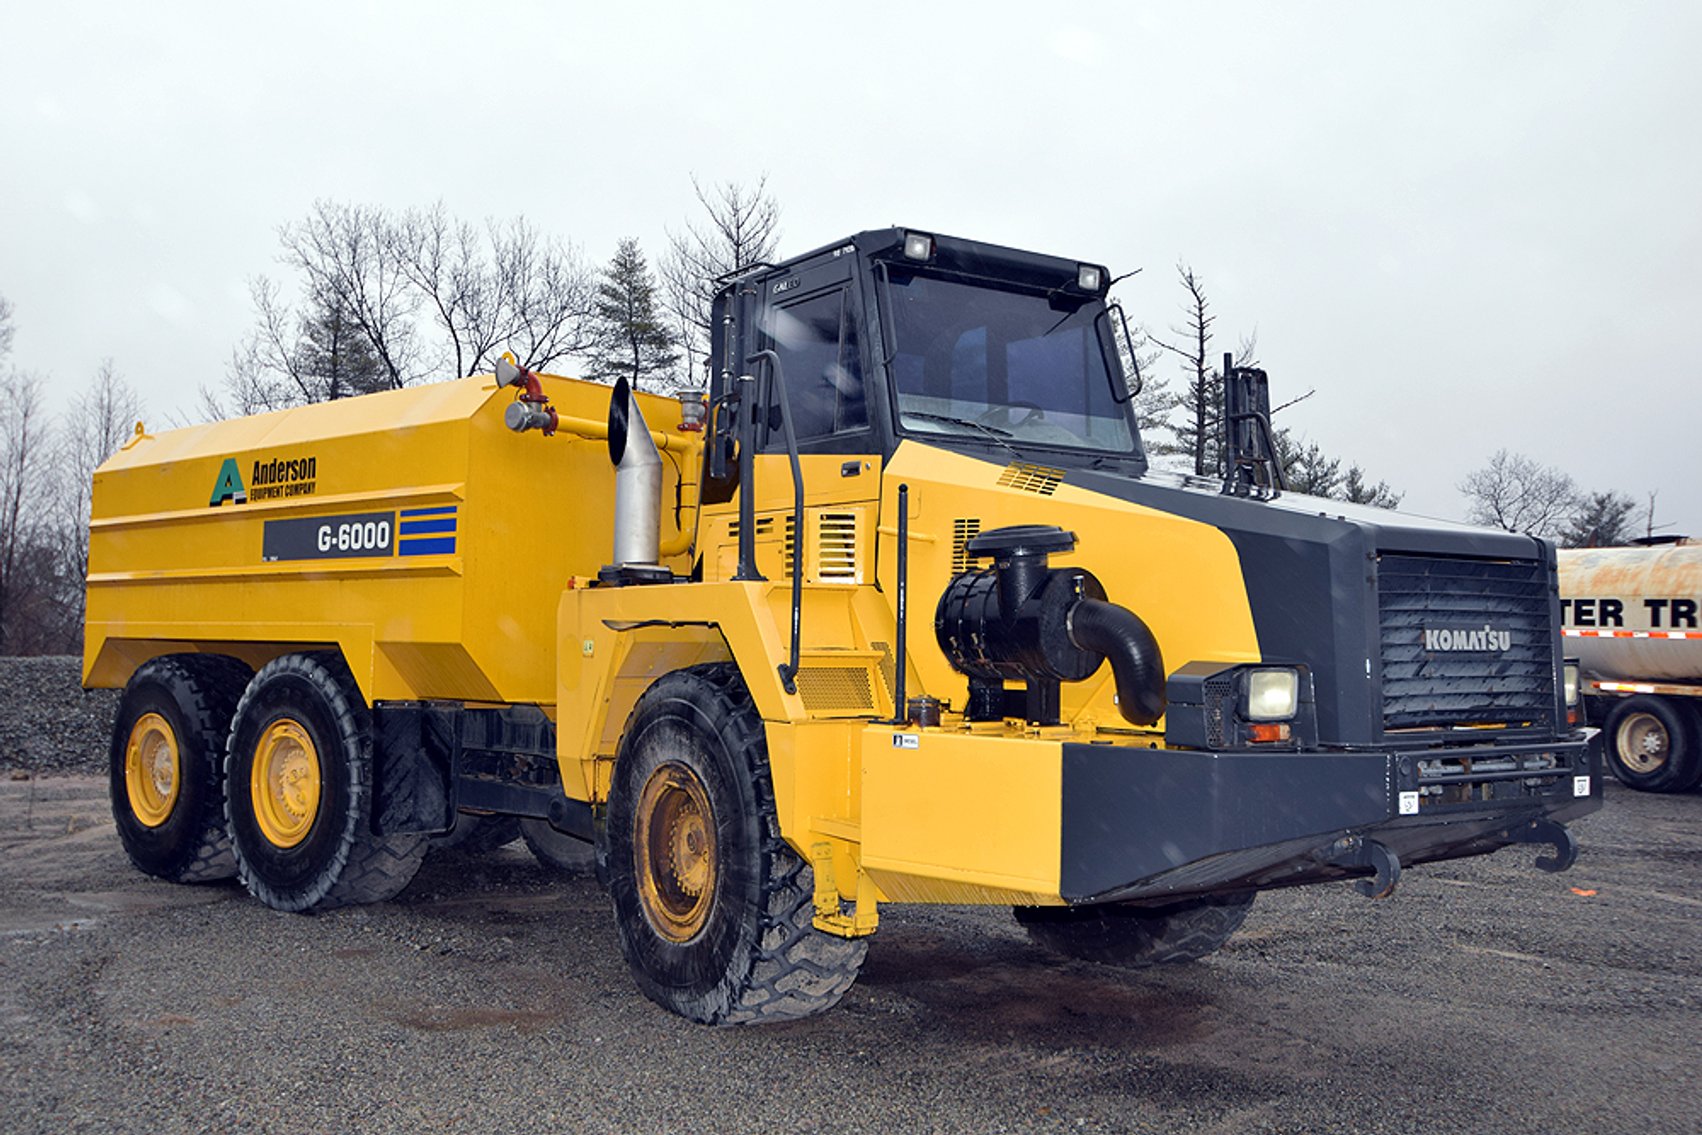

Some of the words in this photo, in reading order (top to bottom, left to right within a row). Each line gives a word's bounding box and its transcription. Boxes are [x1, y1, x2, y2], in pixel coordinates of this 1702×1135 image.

[252, 457, 316, 486] Anderson
[250, 485, 284, 502] EQUIPMENT
[284, 482, 316, 497] COMPANY
[318, 521, 390, 552] G-6000
[1643, 599, 1698, 628] TR
[1424, 625, 1511, 651] KOMATSU
